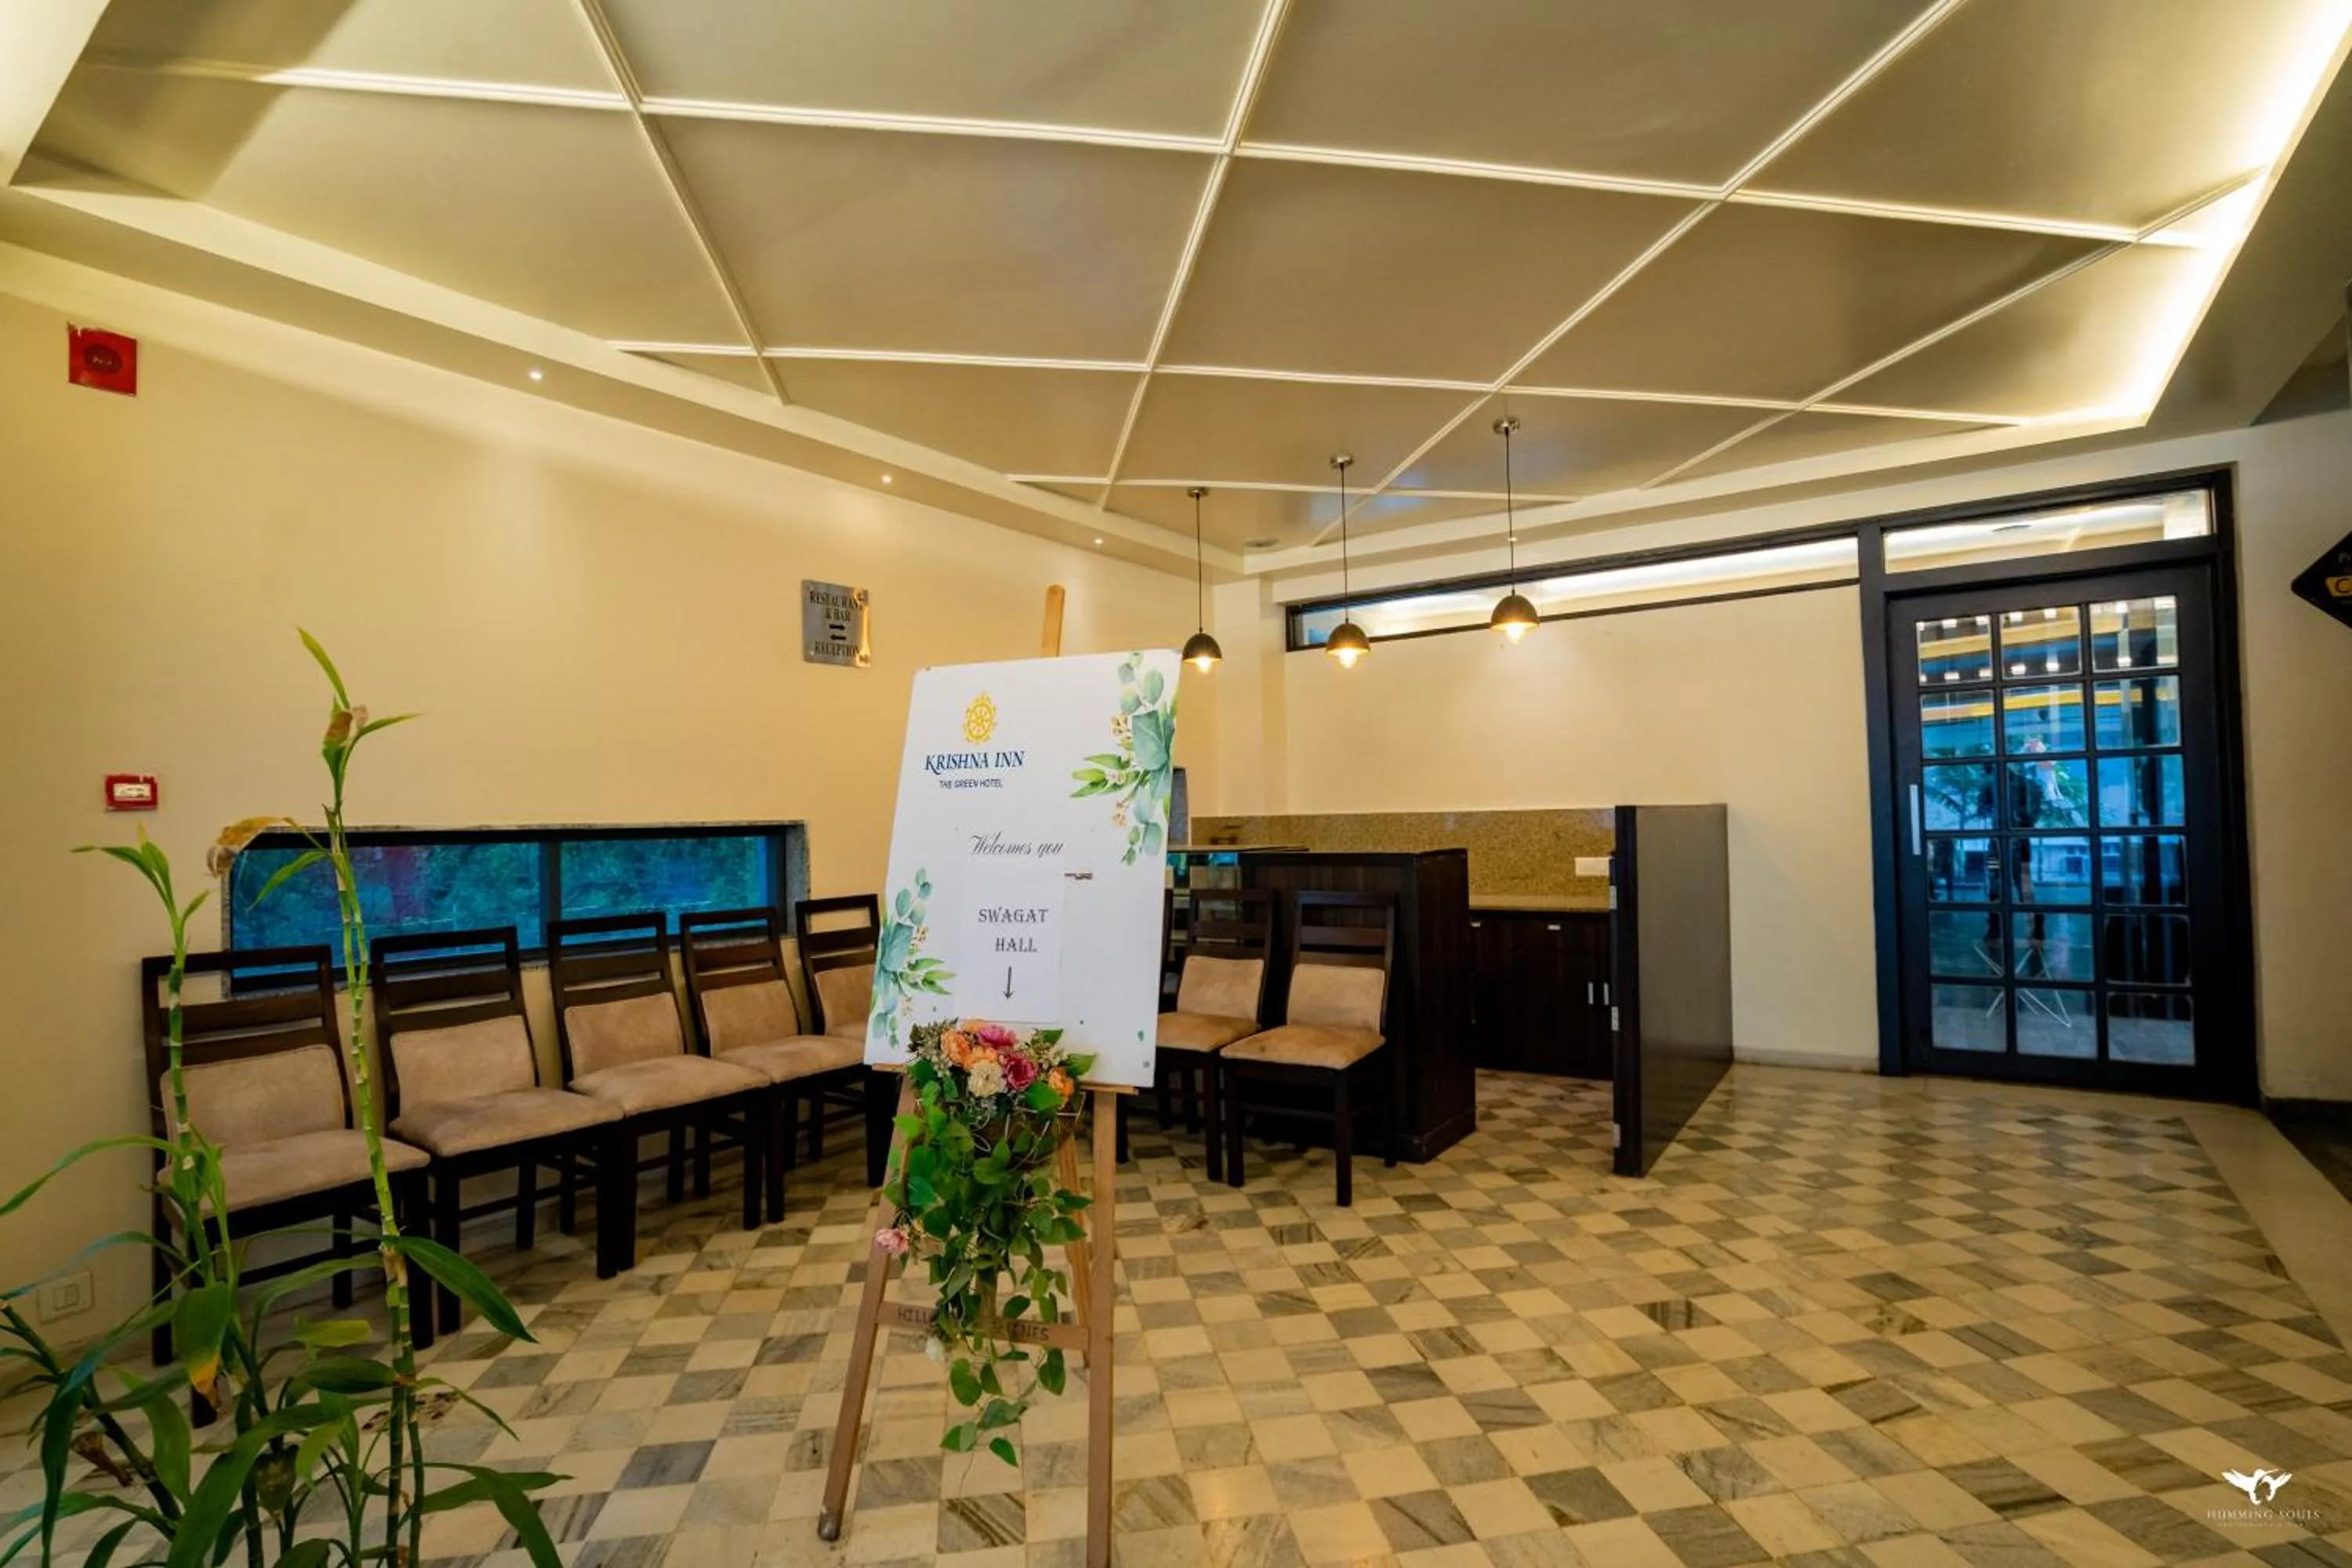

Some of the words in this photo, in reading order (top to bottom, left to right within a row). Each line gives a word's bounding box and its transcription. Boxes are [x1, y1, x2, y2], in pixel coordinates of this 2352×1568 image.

[833, 608, 851, 622] BAR
[924, 753, 989, 775] KRISHNA
[995, 751, 1025, 768] INN
[939, 780, 953, 789] THE
[954, 779, 979, 788] GREEN
[980, 779, 1004, 788] HOTEL
[971, 830, 1033, 855] Welcomes
[1037, 842, 1064, 858] you
[978, 906, 1048, 923] SWAGAT
[995, 937, 1038, 953] HALL
